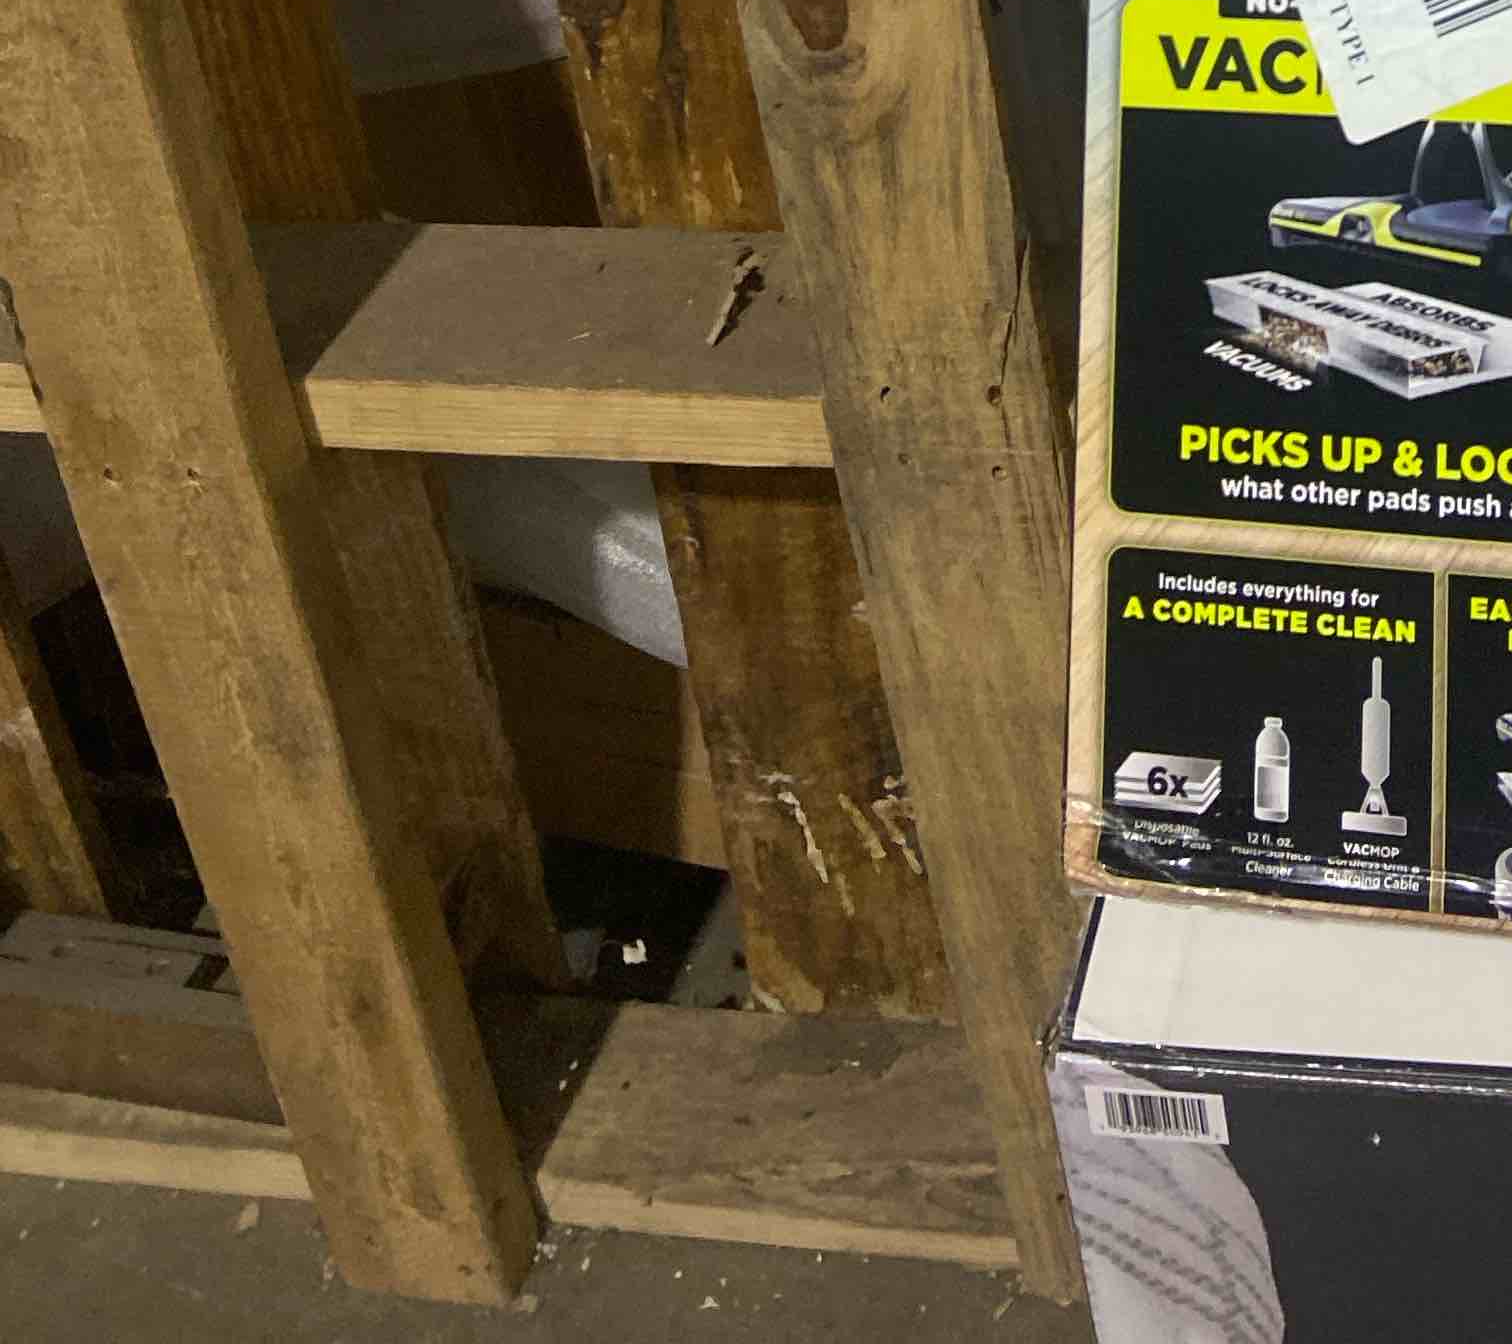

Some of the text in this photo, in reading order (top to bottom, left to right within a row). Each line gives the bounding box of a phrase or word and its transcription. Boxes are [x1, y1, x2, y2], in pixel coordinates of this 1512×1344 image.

[1159, 35, 1322, 96] VAC
[1372, 292, 1496, 332] ABSORBS
[1202, 340, 1312, 392] VACUUMS
[1180, 423, 1310, 468] PICKS
[1321, 435, 1382, 473] UP
[1393, 442, 1423, 478] &
[1221, 474, 1284, 503] what
[1290, 480, 1358, 508] other
[1368, 486, 1431, 515] pads
[1438, 490, 1502, 522] push
[1158, 571, 1379, 609] Includes everything for
[1123, 595, 1416, 644] A COMPLETE CLEAN
[1146, 765, 1188, 800] 6x
[1247, 832, 1294, 848] 12 fl. oz.
[1343, 842, 1400, 858] VACMOP
[1245, 861, 1293, 877] Cleaner
[1383, 877, 1420, 892] Cable
